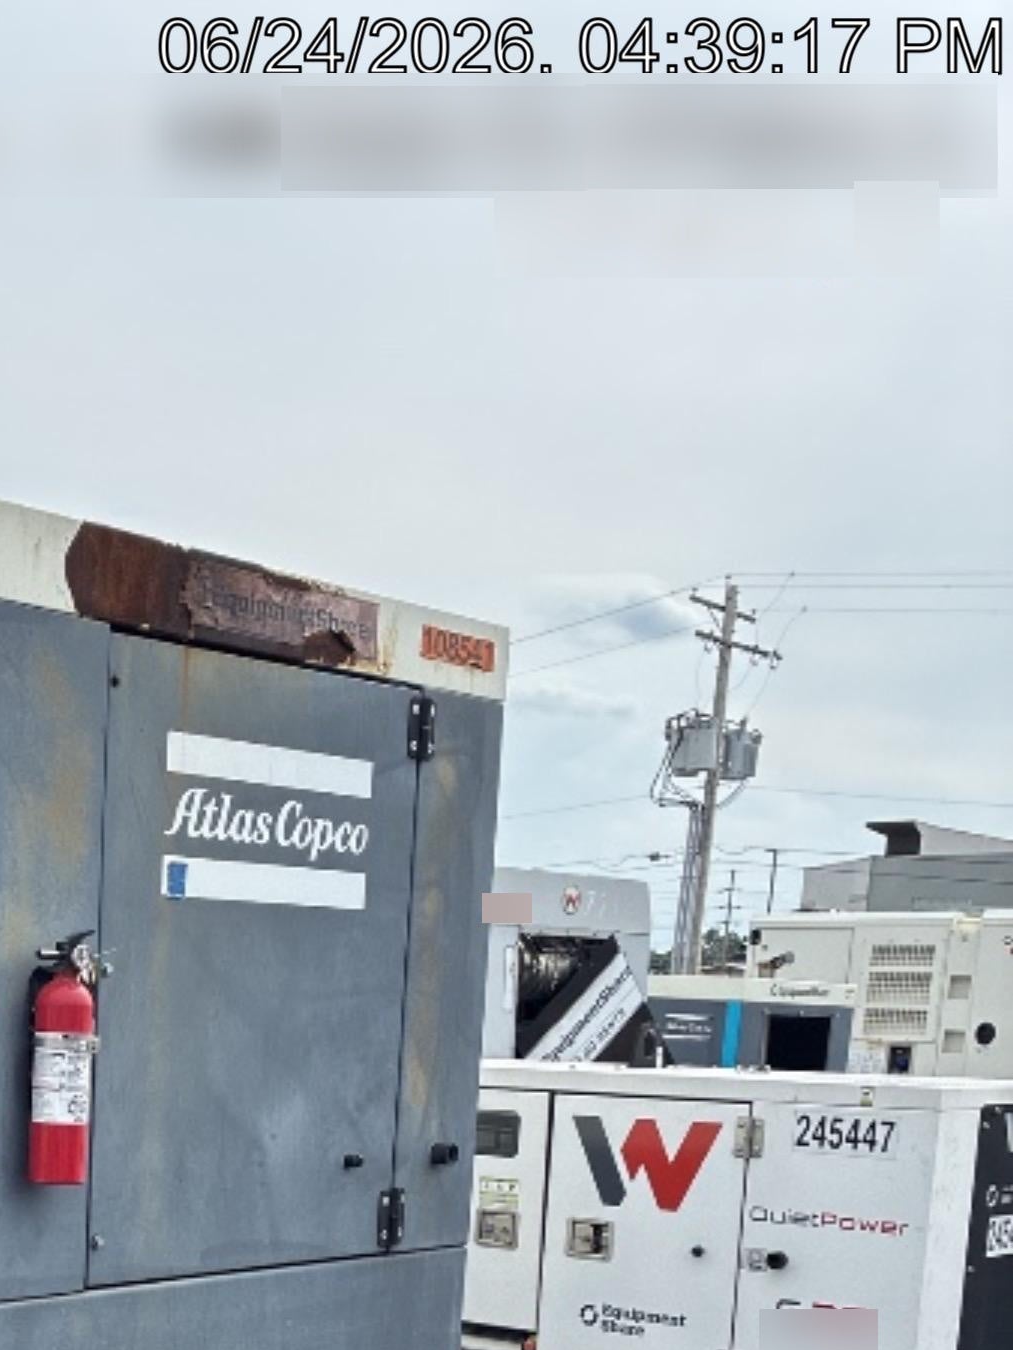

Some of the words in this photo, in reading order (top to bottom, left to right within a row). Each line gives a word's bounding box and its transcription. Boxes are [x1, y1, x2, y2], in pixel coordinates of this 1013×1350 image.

[163, 787, 274, 845] Atlas
[274, 799, 369, 862] Copco
[795, 1114, 897, 1153] 245447
[749, 1205, 910, 1237] QuietPower
